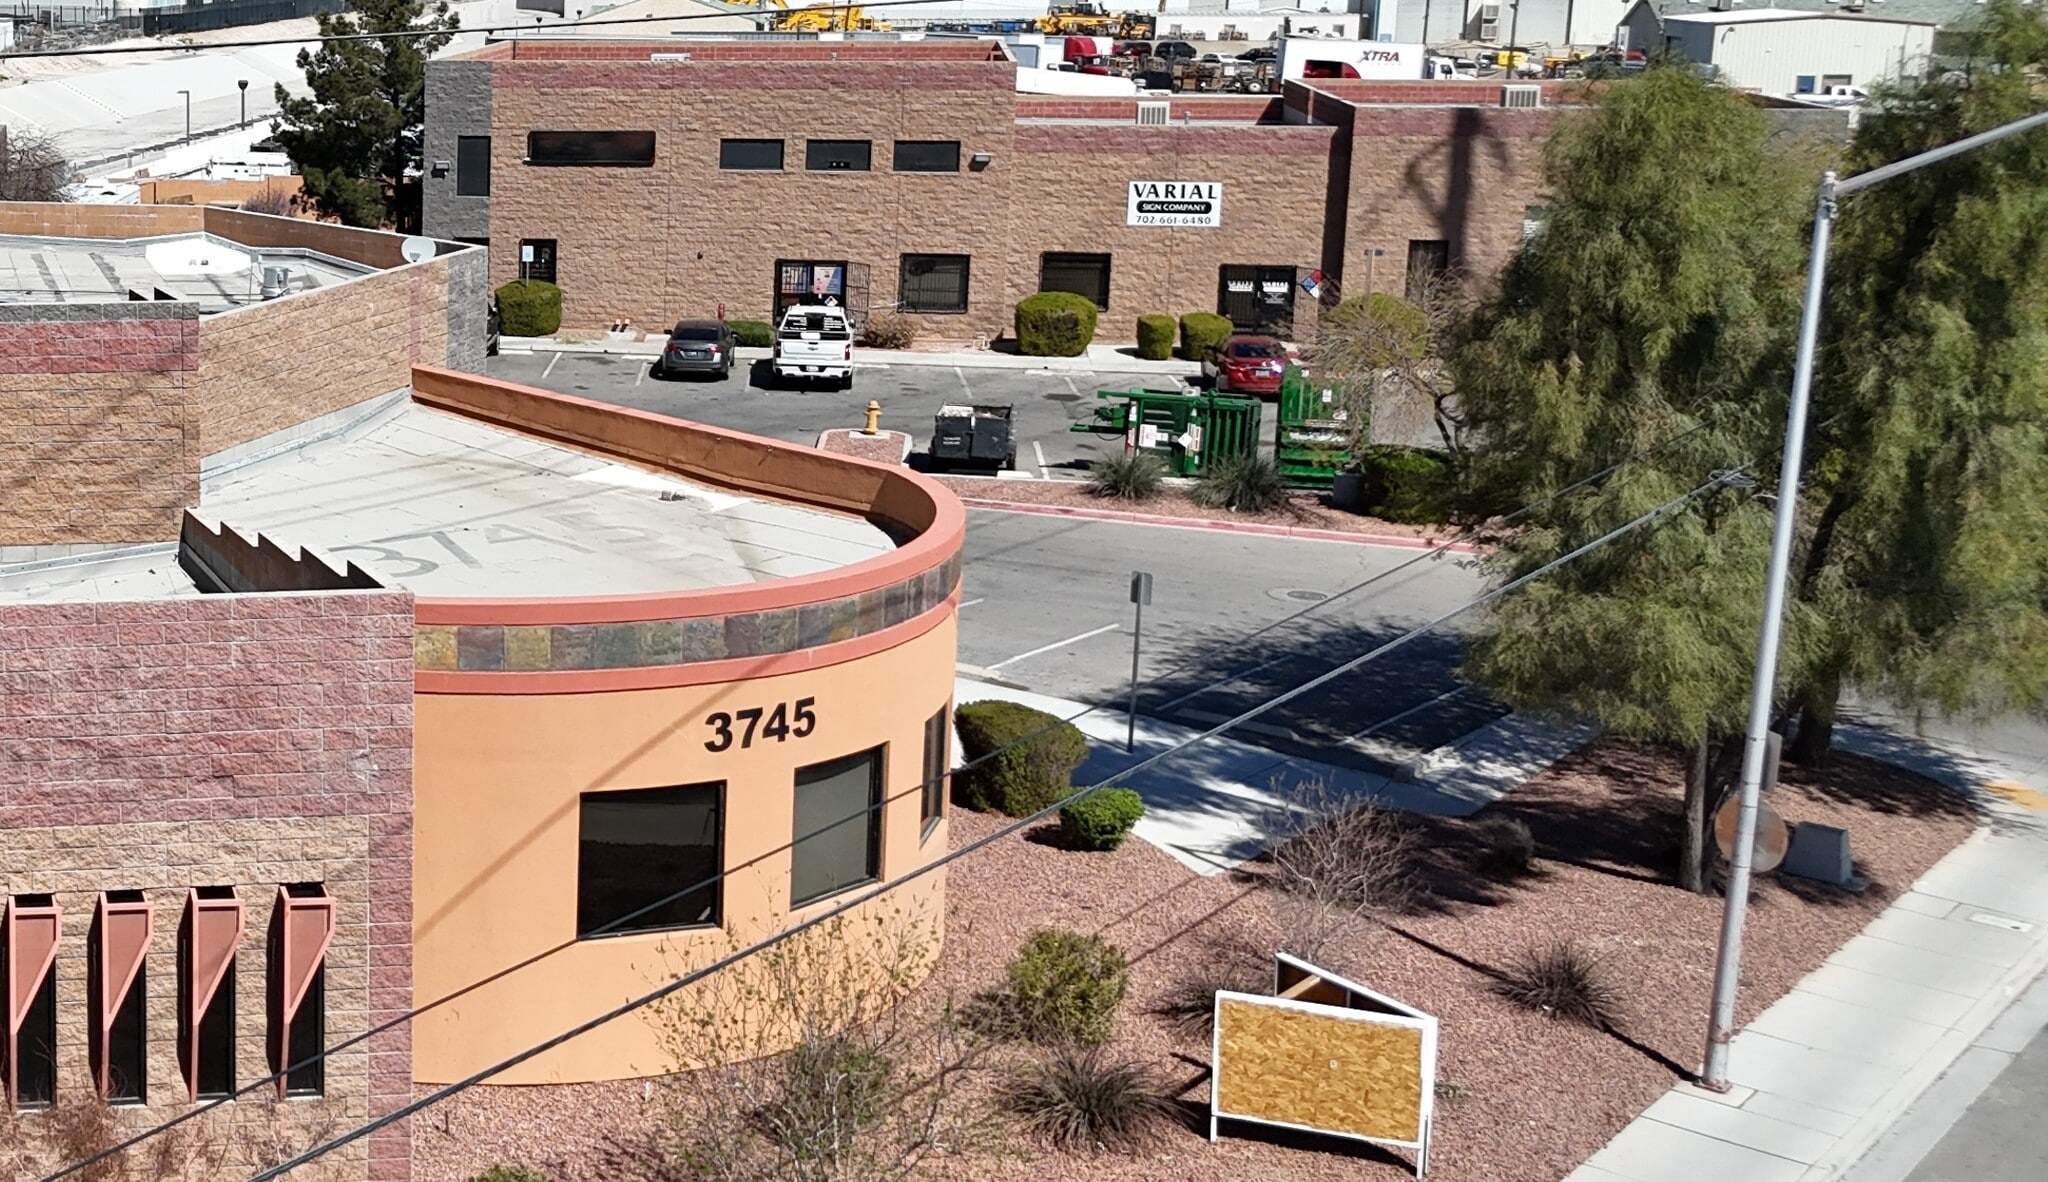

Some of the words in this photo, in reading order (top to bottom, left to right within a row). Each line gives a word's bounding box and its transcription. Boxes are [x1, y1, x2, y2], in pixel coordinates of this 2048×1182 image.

[1356, 50, 1399, 63] XTRA
[1133, 184, 1217, 199] VARIAL
[1142, 203, 1161, 211] SIGN
[1163, 203, 1206, 212] COMPANY
[704, 696, 816, 752] 3745
